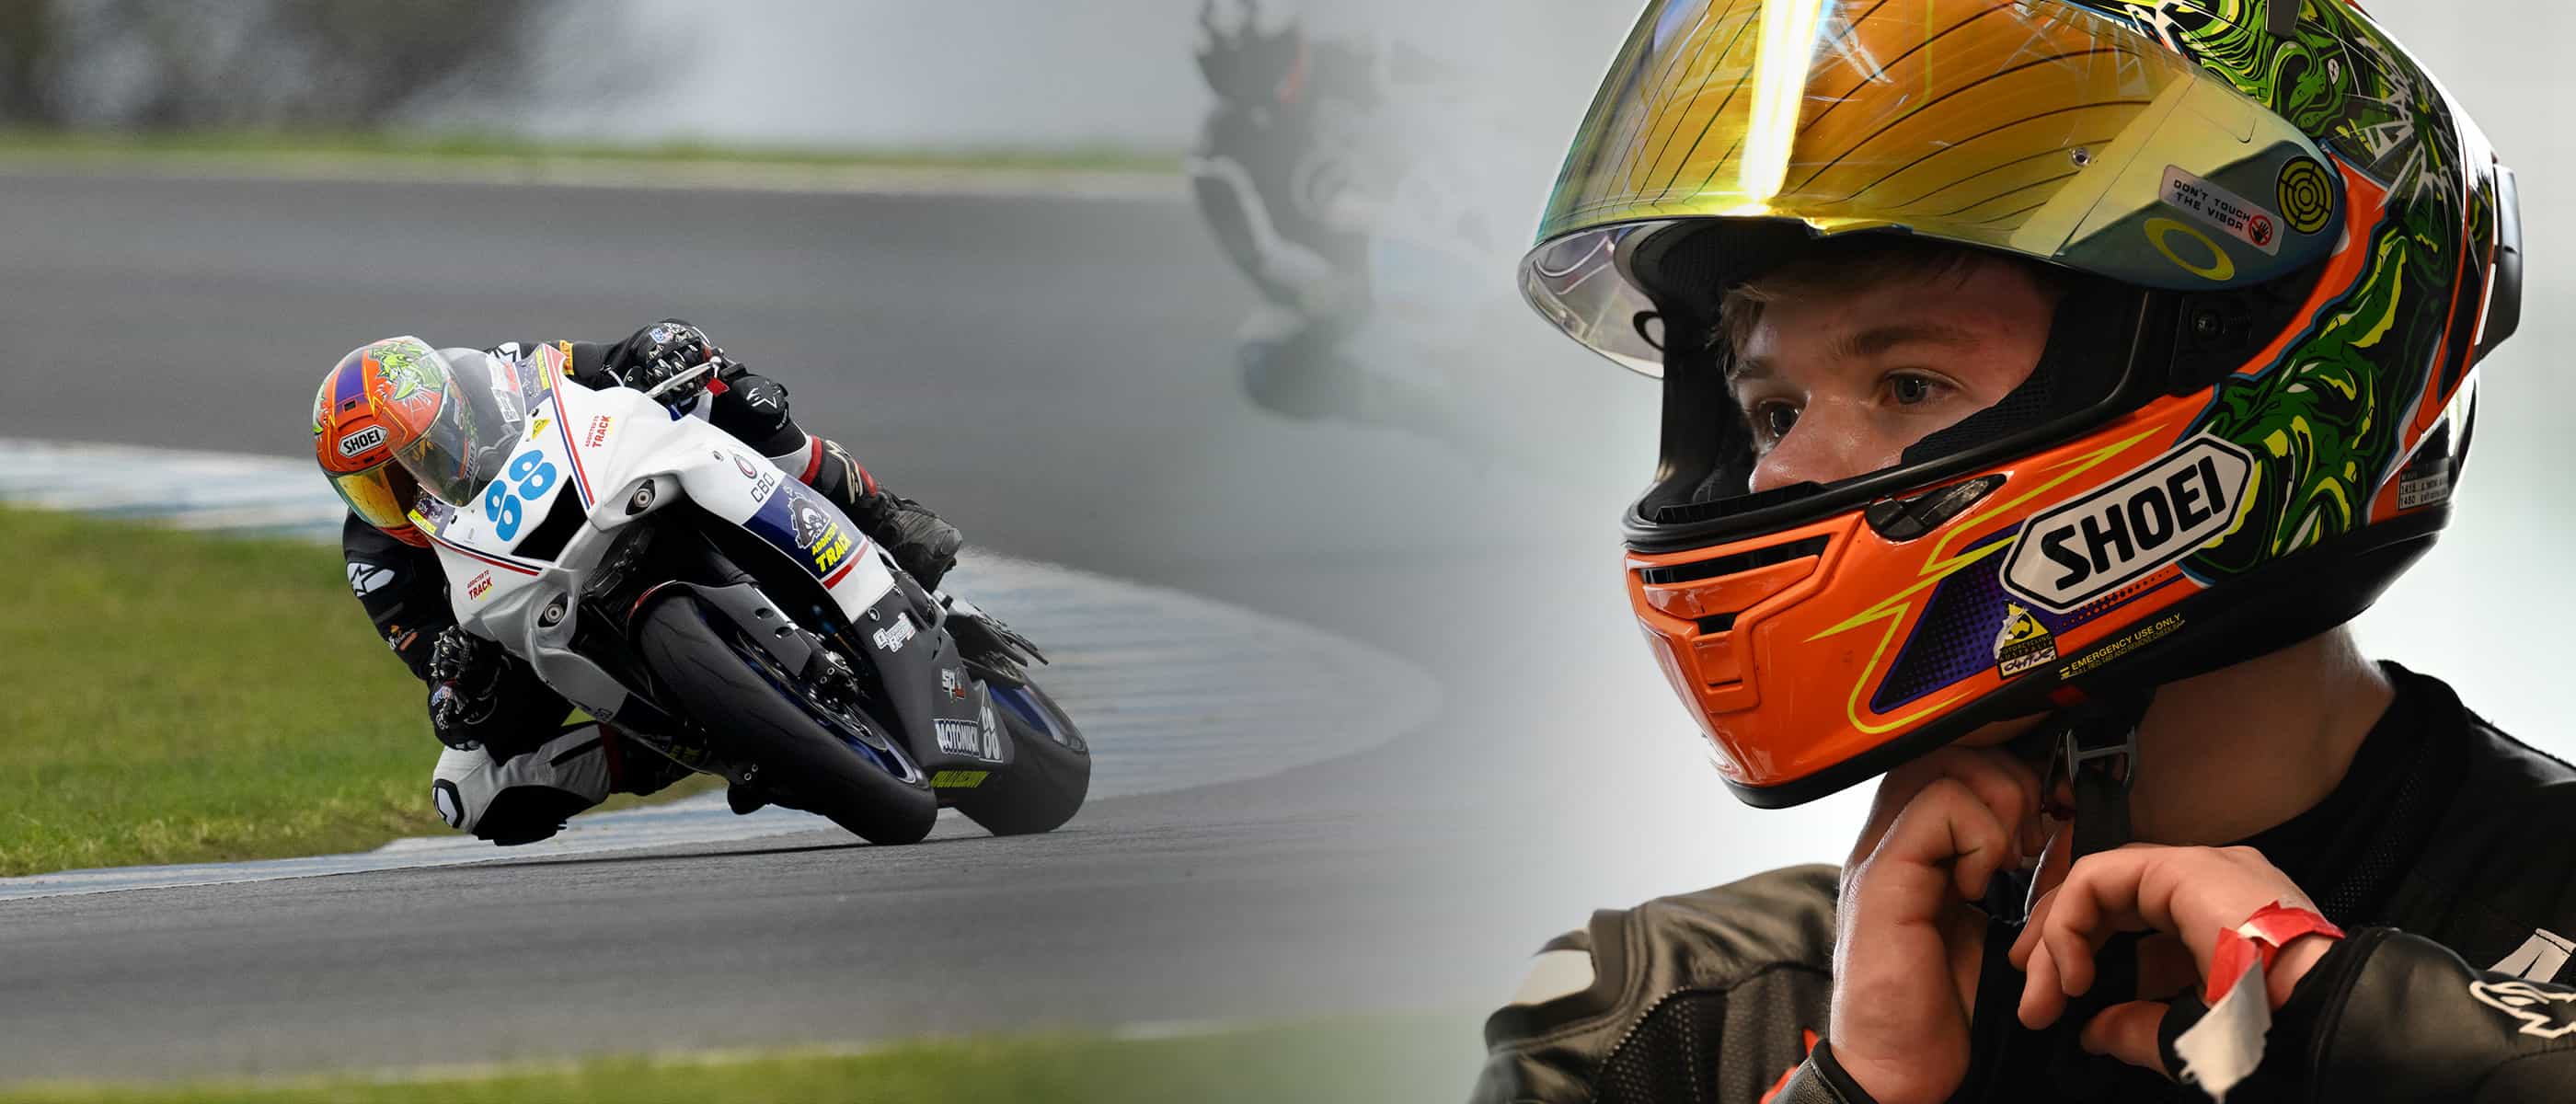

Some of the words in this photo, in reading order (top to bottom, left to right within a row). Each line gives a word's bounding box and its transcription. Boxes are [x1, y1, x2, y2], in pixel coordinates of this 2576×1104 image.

[2173, 179, 2208, 201] DON'T
[2214, 198, 2251, 222] TOUCH
[2177, 191, 2202, 211] THE
[2208, 206, 2245, 232] VISOR
[342, 429, 382, 454] SHOEI
[592, 415, 612, 448] TRACK
[485, 449, 558, 542] 88
[2039, 455, 2225, 592] SHOEI
[815, 532, 853, 572] TRACK
[468, 576, 493, 600] TRACK
[2000, 634, 2053, 656] OTORCYCLING
[2071, 636, 2133, 671] EMERGENCY
[2133, 626, 2154, 640] USE
[2155, 613, 2180, 630] ONLY
